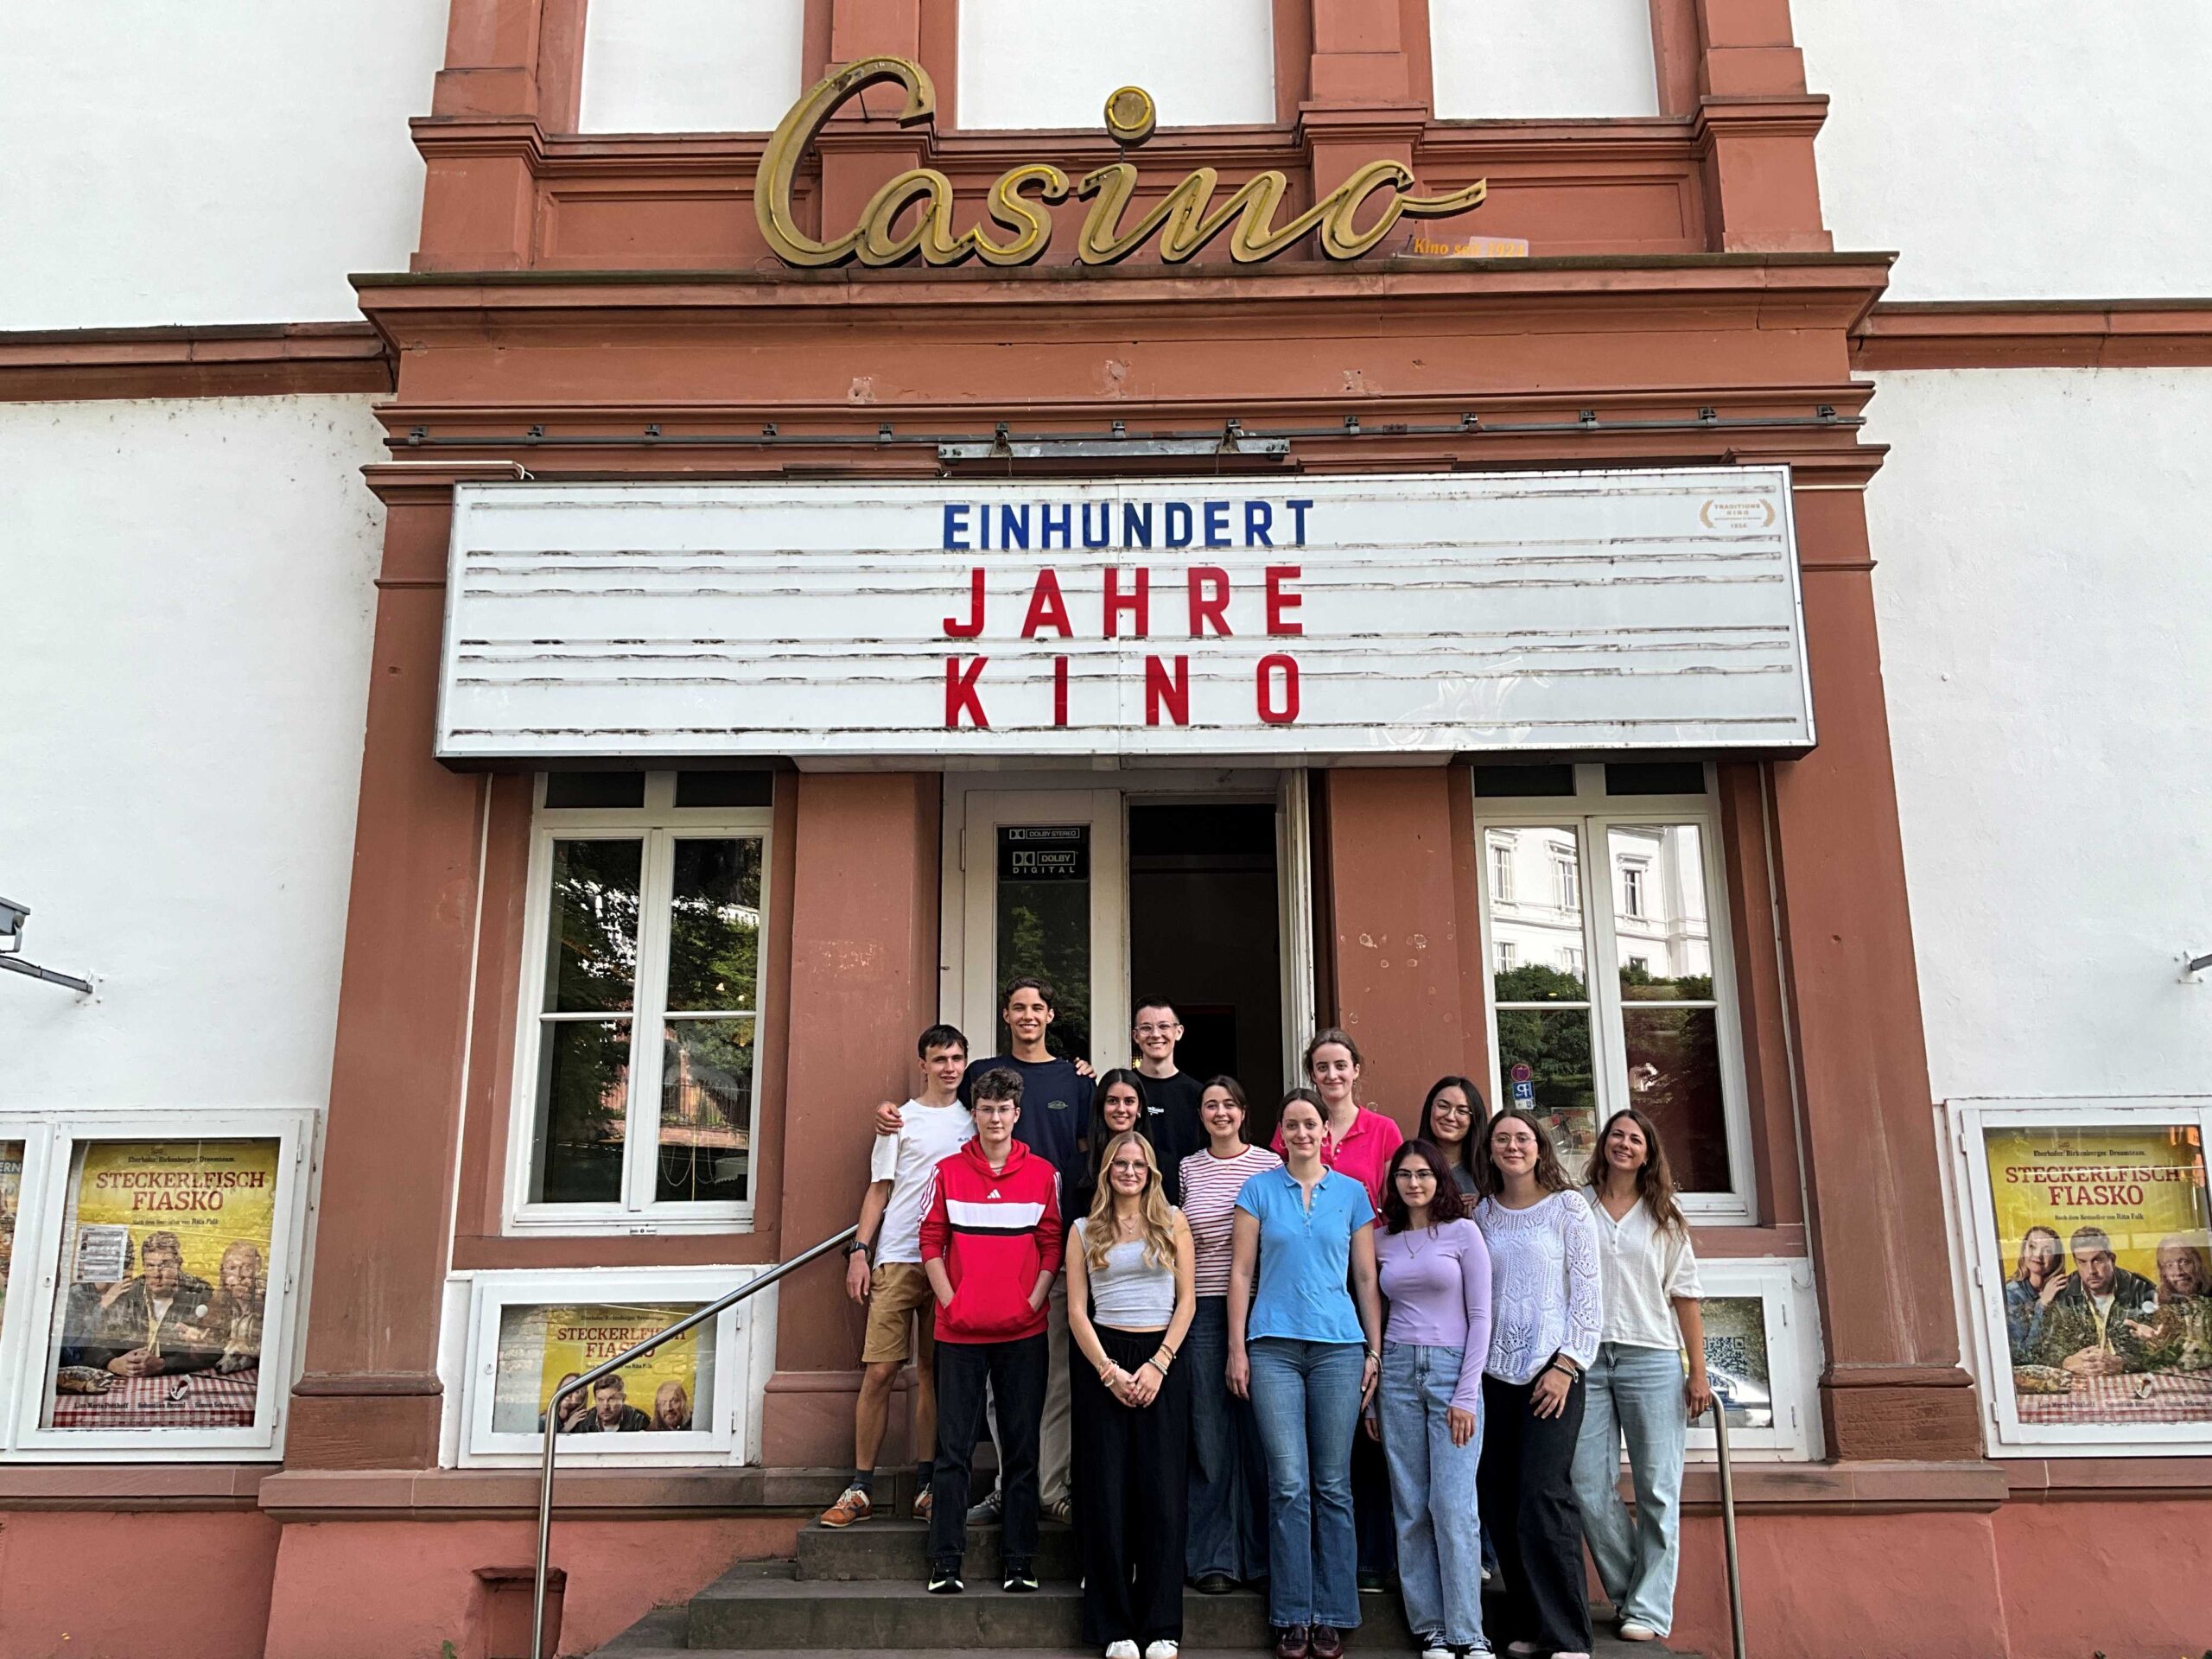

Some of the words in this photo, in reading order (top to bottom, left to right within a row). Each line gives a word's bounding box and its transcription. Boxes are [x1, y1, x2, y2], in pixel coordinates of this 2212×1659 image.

[754, 55, 1487, 268] Casino
[1414, 238, 1449, 254] Kino
[1486, 241, 1524, 257] 1924
[943, 499, 1313, 550] EINHUNDERT
[943, 566, 1303, 638] JAHRE
[945, 654, 1300, 728] KINO
[96, 1172, 265, 1189] STECKERLFISCH
[2005, 1166, 2181, 1183] STECKERLFISCH
[131, 1191, 224, 1211] FIASKO
[2048, 1185, 2144, 1205] FIASKO
